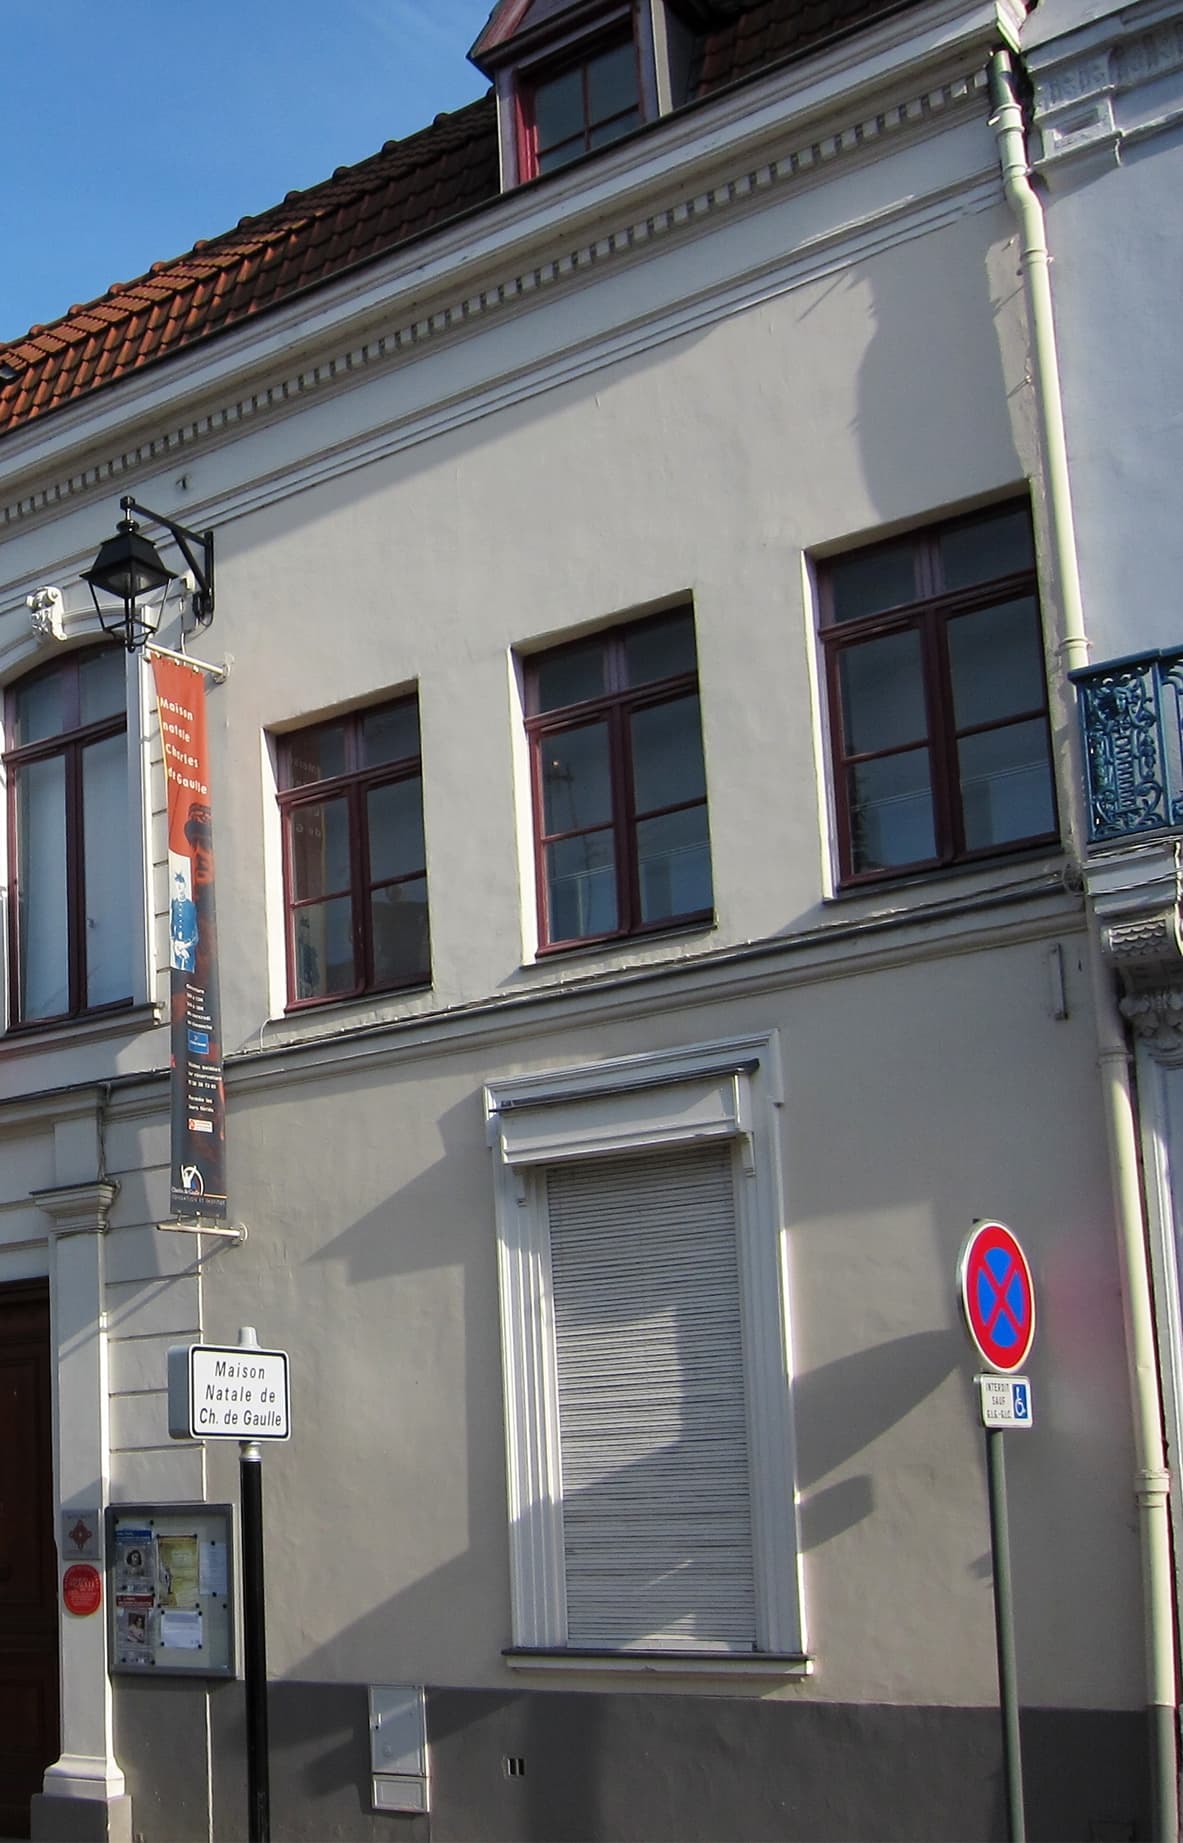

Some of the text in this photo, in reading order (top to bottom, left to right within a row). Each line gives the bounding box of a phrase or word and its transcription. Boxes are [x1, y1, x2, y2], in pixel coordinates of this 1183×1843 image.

[176, 772, 208, 795] Gaulle
[215, 1360, 265, 1379] Maison
[205, 1384, 276, 1403] Natale de
[199, 1407, 282, 1426] Ch. de Gaulle
